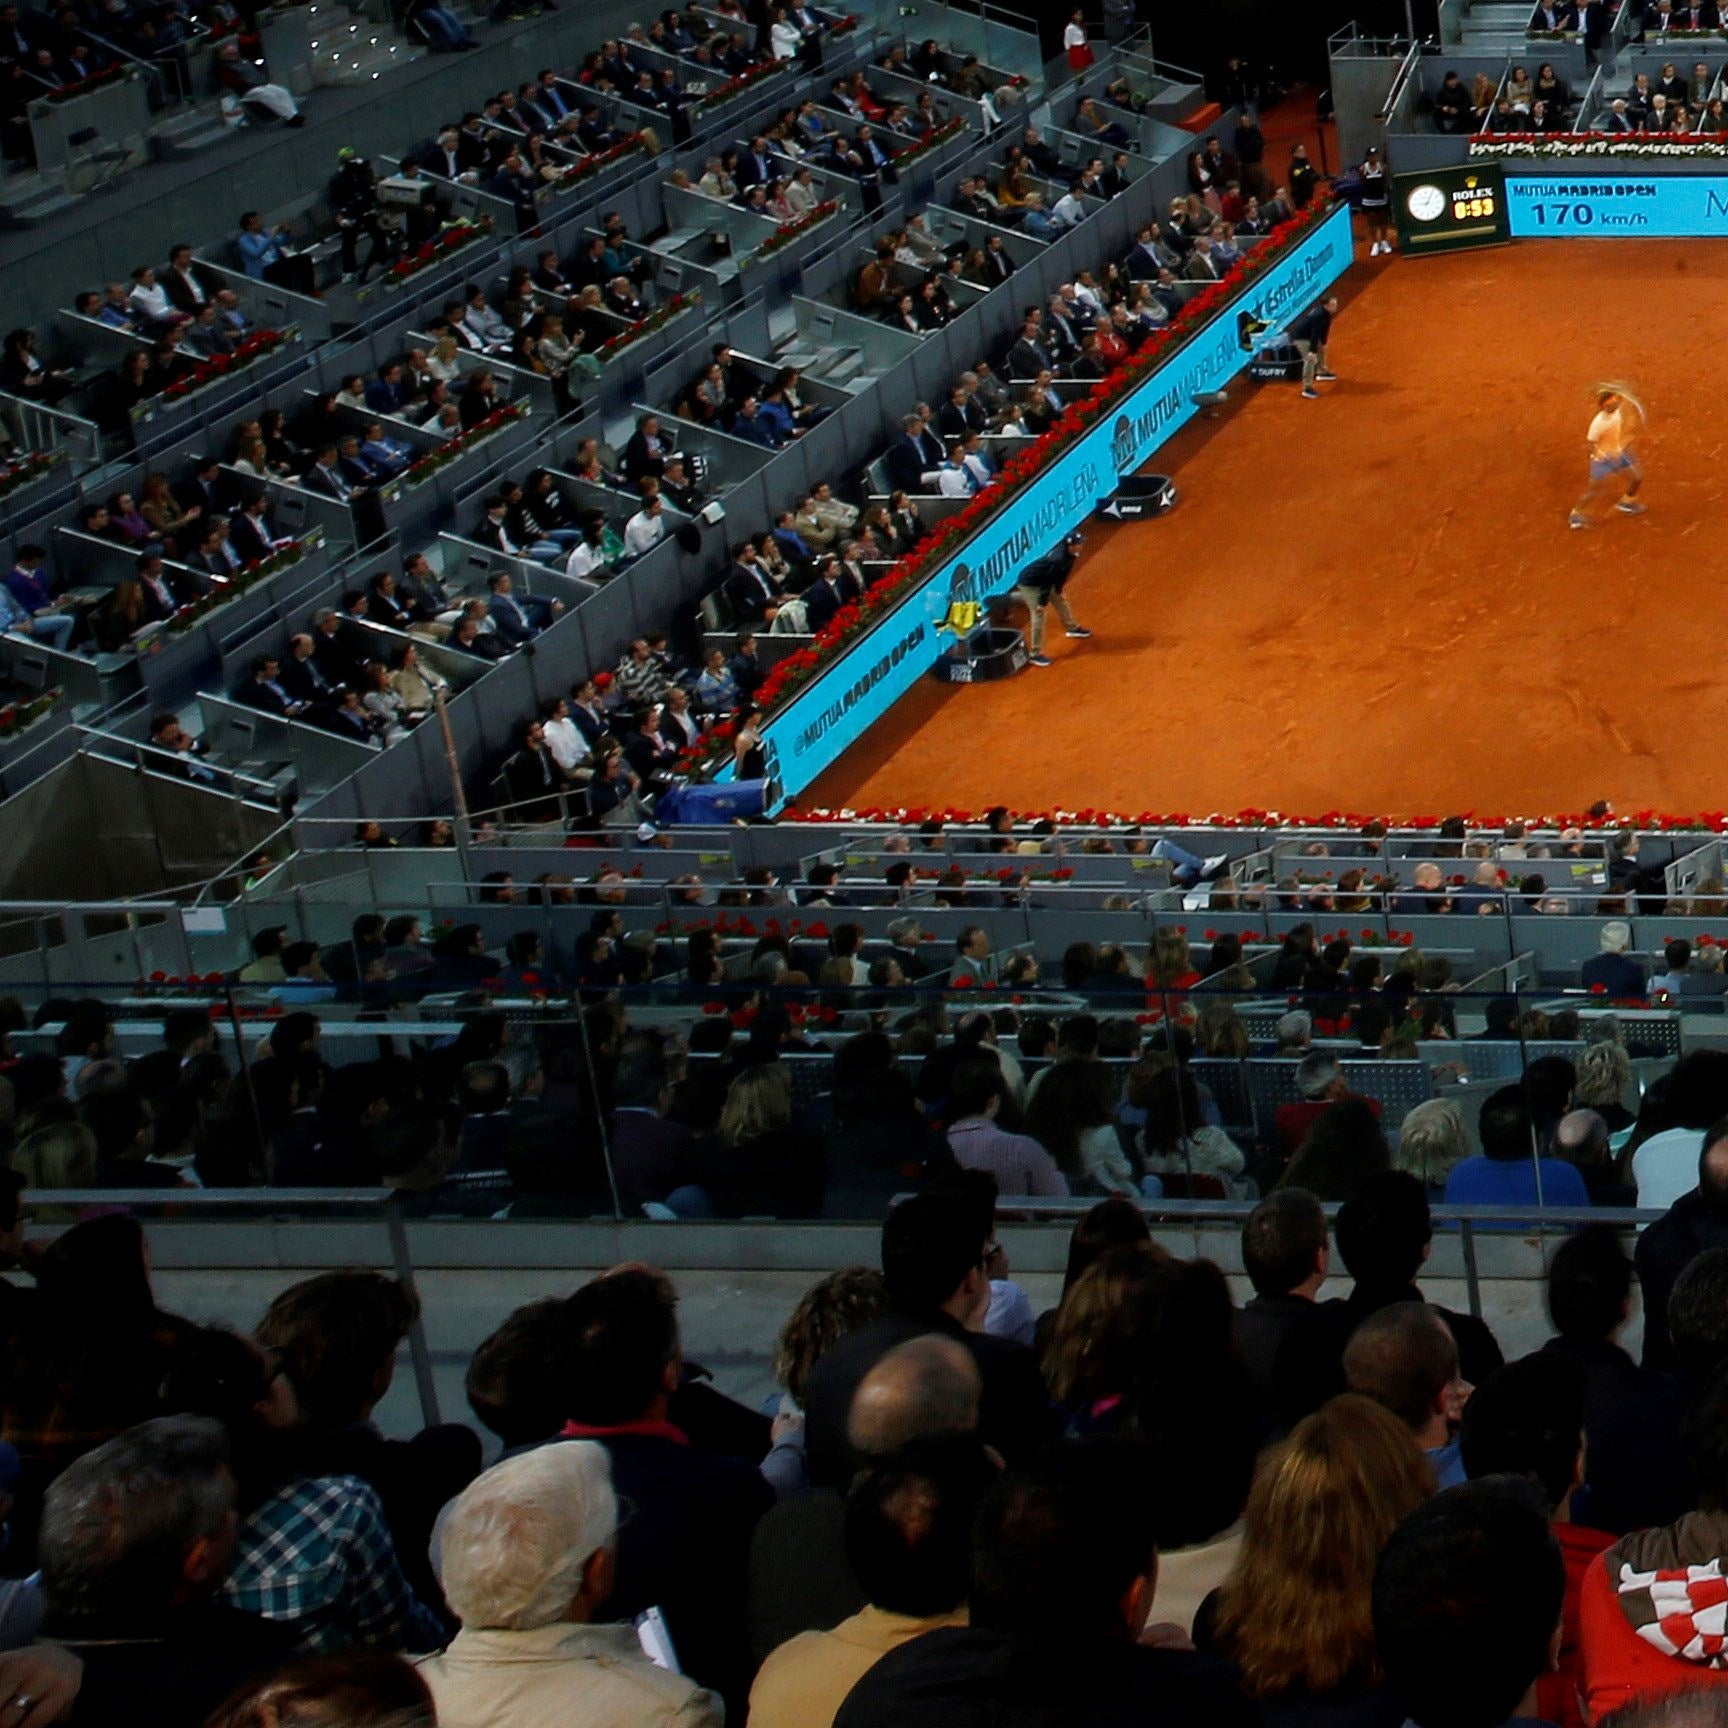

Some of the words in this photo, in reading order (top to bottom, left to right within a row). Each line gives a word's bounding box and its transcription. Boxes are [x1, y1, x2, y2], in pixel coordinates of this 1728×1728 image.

[1452, 186, 1495, 202] ROLEX
[1531, 203, 1594, 225] 170
[1601, 212, 1648, 226] km/h
